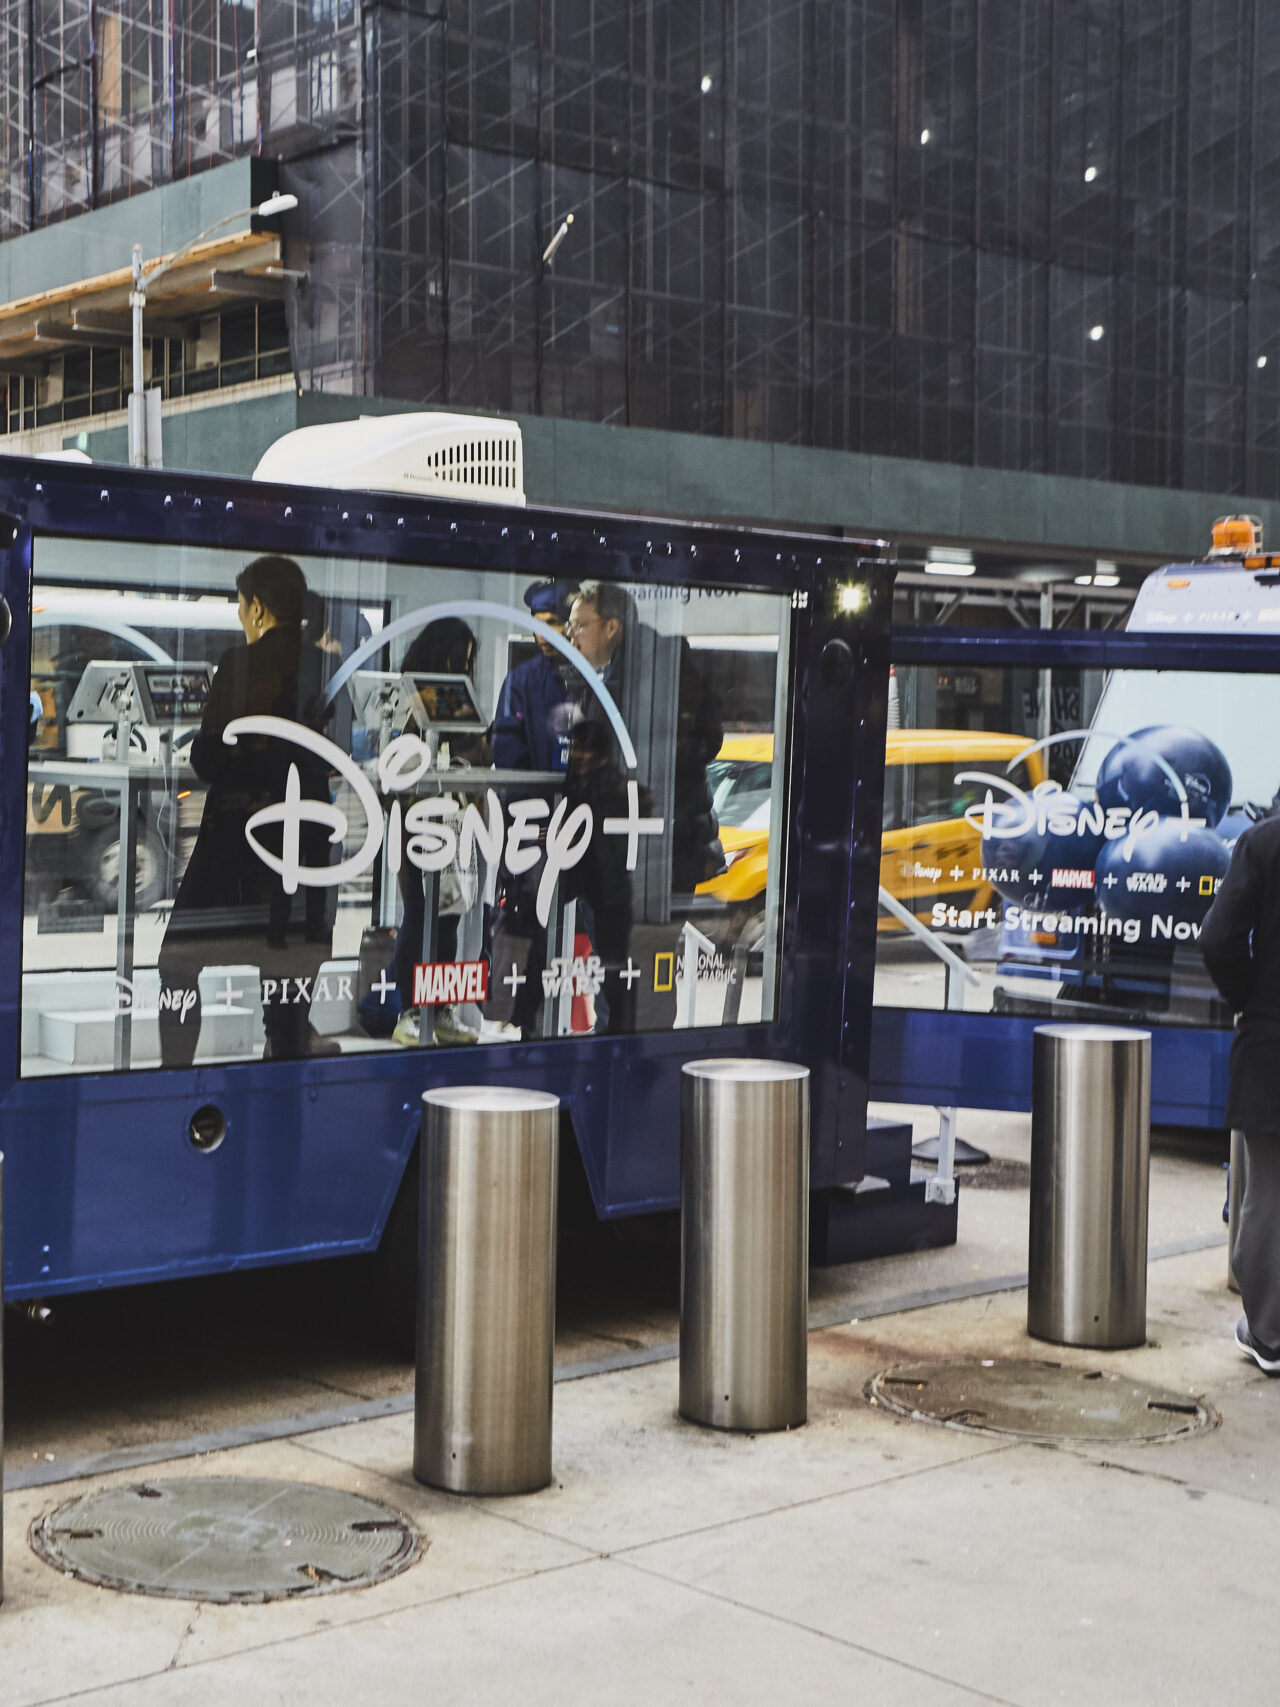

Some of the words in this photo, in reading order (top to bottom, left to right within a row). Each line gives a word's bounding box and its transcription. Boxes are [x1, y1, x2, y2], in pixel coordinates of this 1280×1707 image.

[972, 868, 1020, 883] PIXAR
[1052, 869, 1095, 888] MARVEL
[931, 903, 997, 929] Start
[1005, 906, 1141, 943] Streaming
[542, 955, 605, 977] STAR
[676, 953, 724, 971] NIONAL
[262, 975, 355, 1005] PIXAR
[414, 962, 486, 1004] MARVEL
[542, 975, 605, 998] WARS
[675, 968, 737, 985] GGRAPHIC
